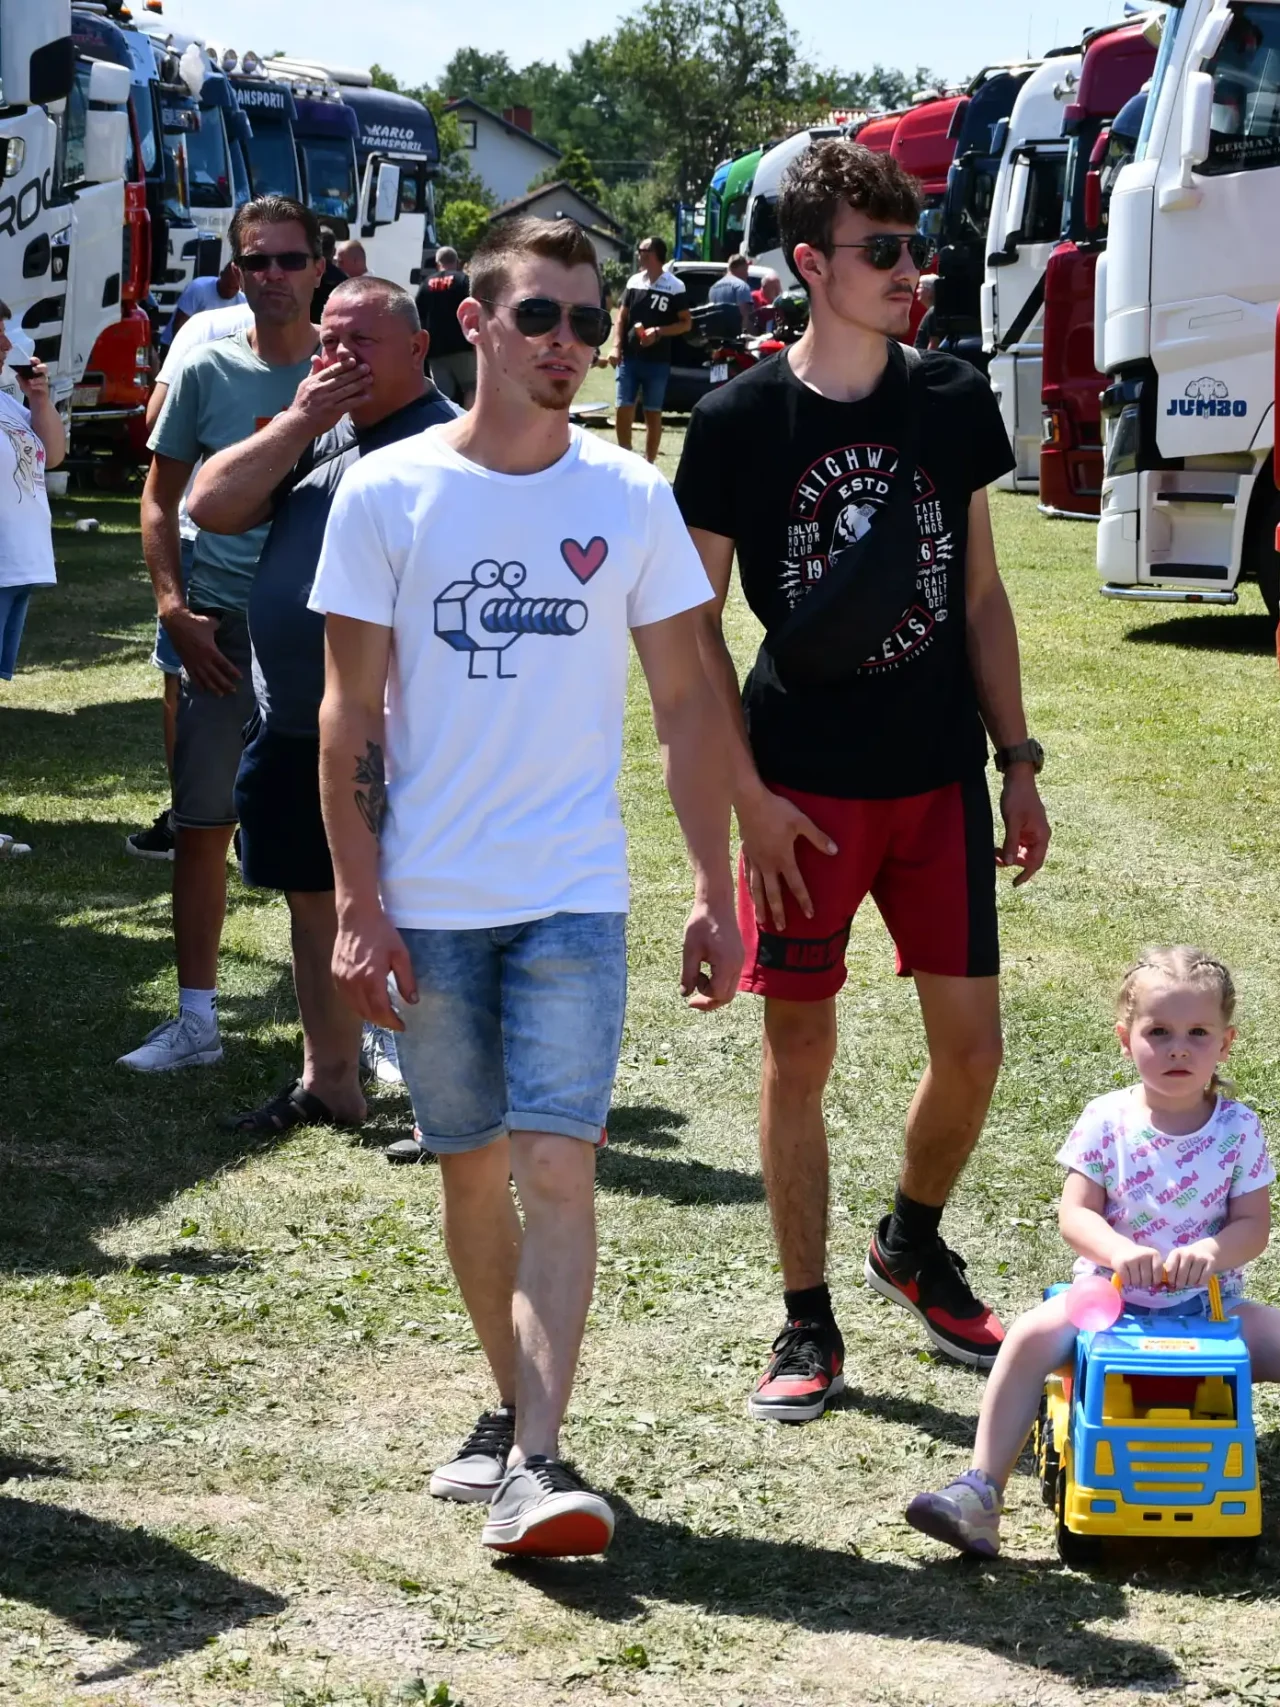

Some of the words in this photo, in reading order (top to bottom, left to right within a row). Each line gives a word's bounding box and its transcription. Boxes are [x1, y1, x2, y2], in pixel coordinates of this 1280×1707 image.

[236, 88, 284, 109] ANSPORTI
[369, 124, 415, 140] KARLO
[361, 136, 422, 151] TRANSPORTI
[650, 294, 669, 312] 76
[1166, 399, 1247, 417] JUMBO
[838, 477, 889, 500] ESTD
[914, 500, 941, 515] TATE
[916, 511, 942, 526] PEED
[920, 521, 944, 536] INGS
[806, 559, 823, 580] 19
[916, 573, 948, 590] OCALS
[1177, 1136, 1204, 1153] GIRL
[1217, 1133, 1241, 1154] GIRL
[1172, 1187, 1198, 1209] GIRL
